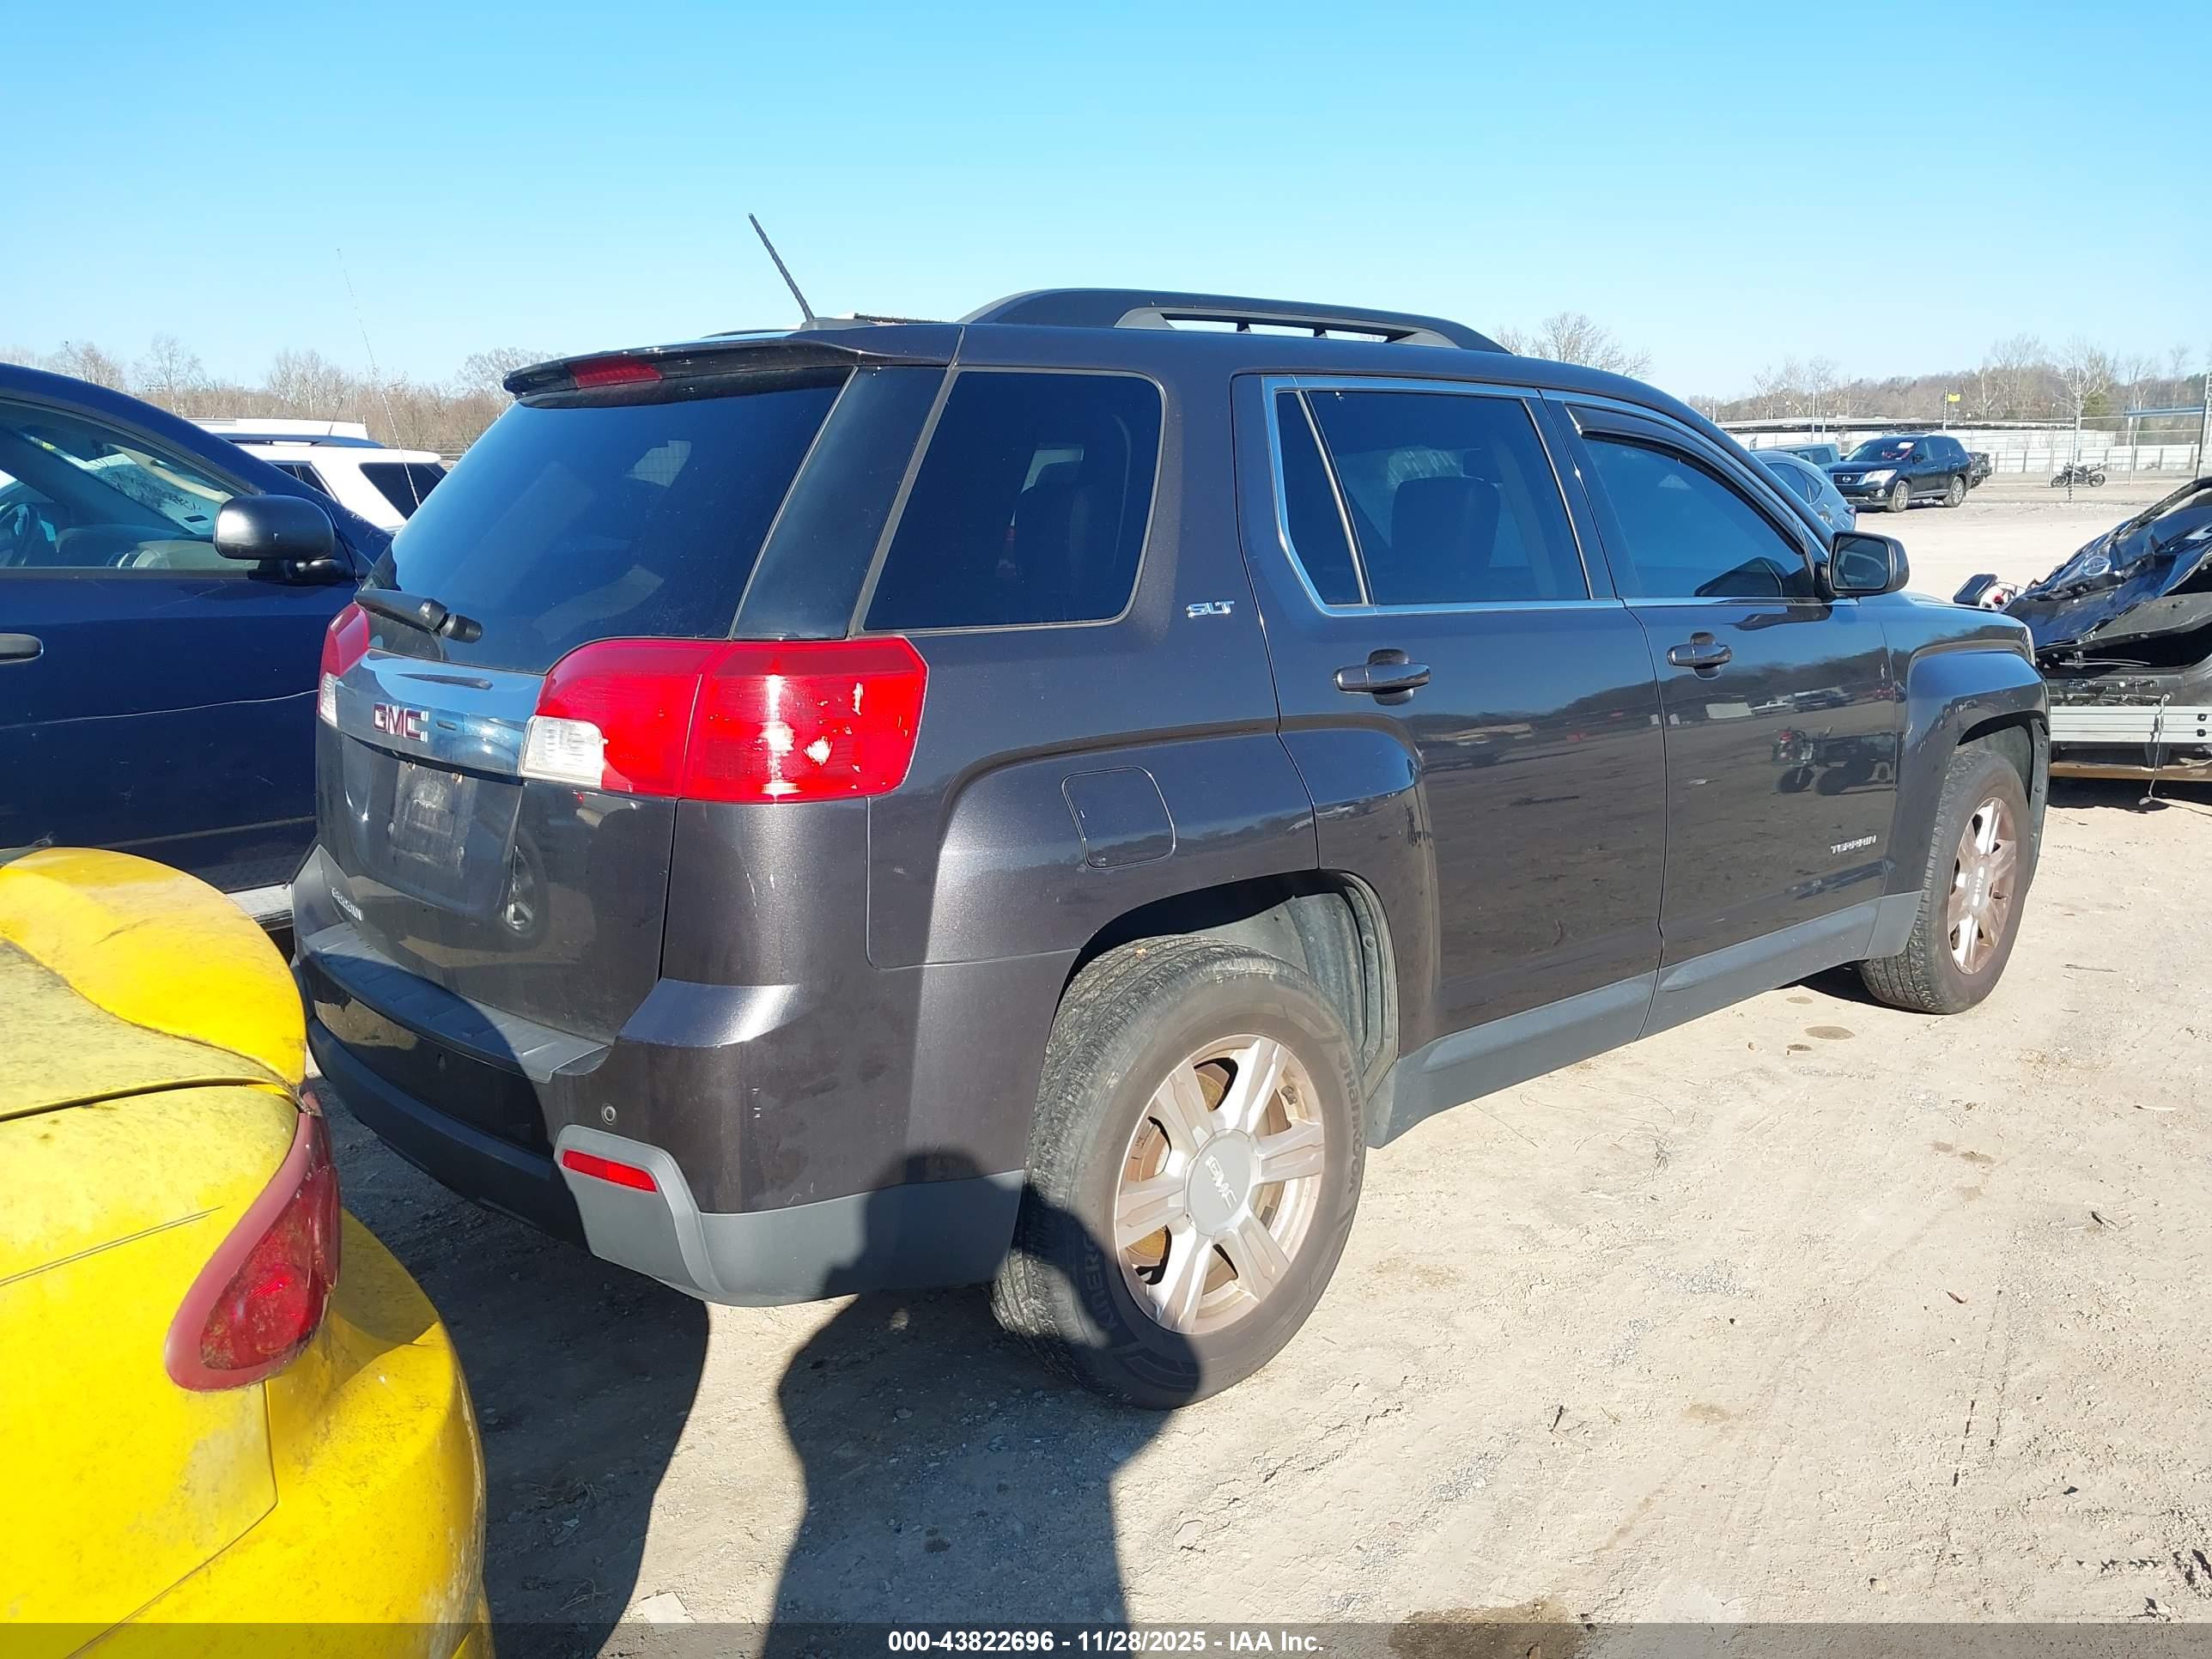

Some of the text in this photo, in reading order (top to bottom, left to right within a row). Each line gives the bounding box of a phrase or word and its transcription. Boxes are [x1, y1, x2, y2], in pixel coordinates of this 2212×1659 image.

[1186, 600, 1235, 618] SLT
[373, 702, 429, 743] GMC
[1206, 1154, 1237, 1209] GMC
